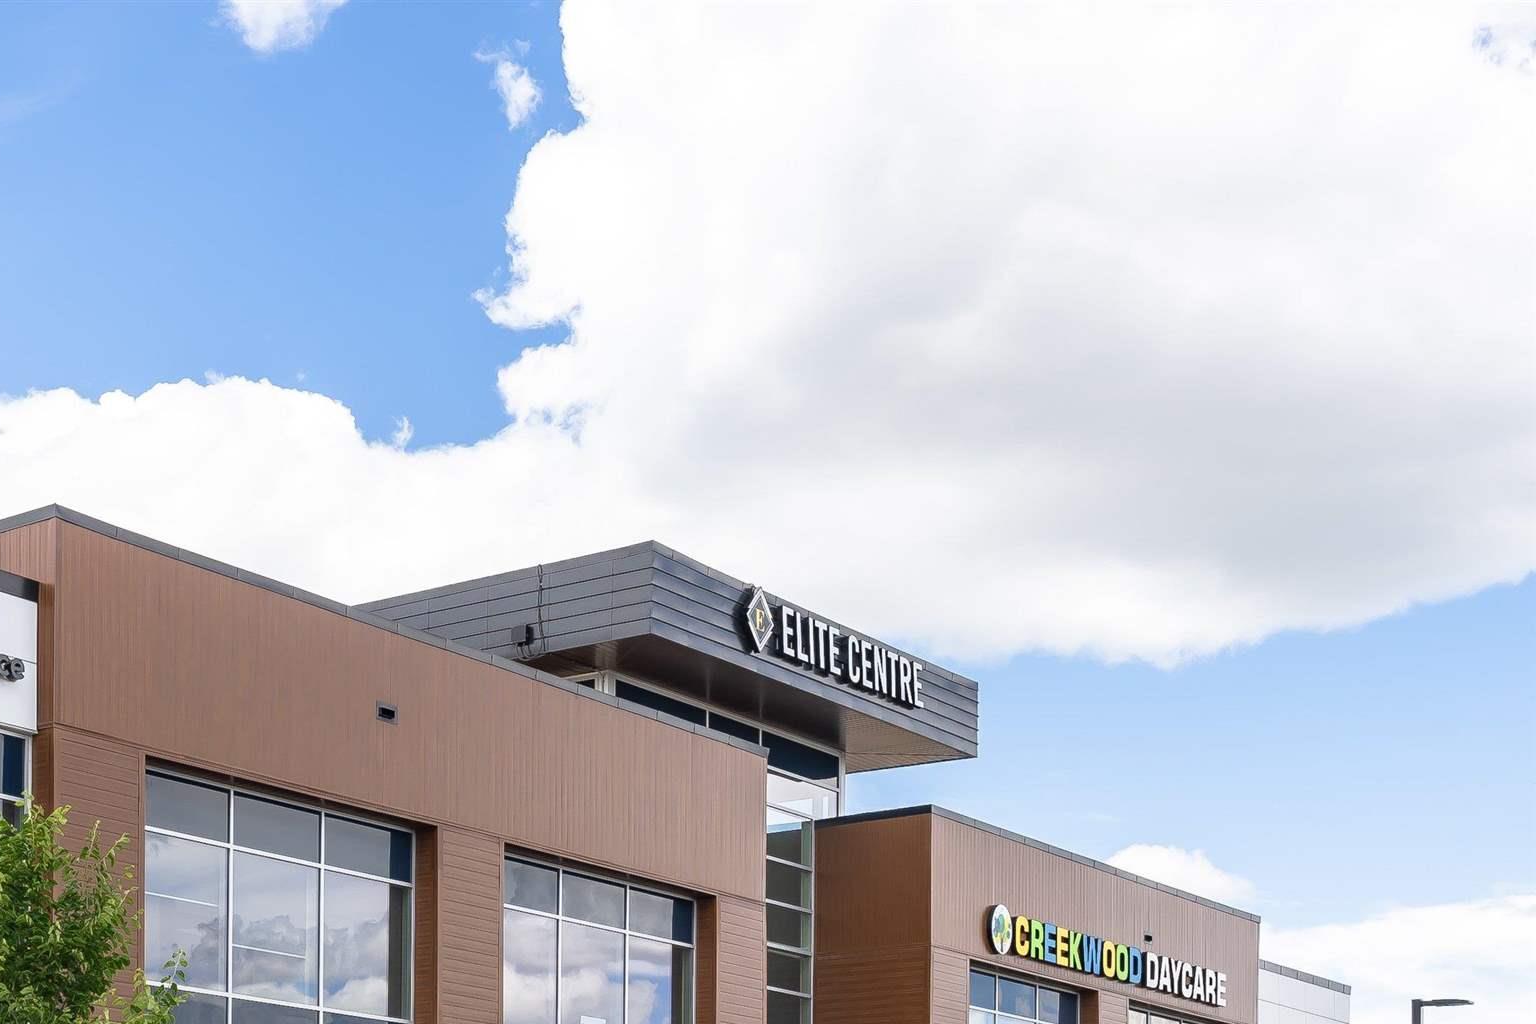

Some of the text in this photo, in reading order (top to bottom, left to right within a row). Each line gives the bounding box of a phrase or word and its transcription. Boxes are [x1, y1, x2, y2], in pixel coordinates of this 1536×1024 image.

[781, 605, 924, 708] ELITE CENTRE
[1015, 915, 1227, 1006] CREEKWOOD DAYCARE
